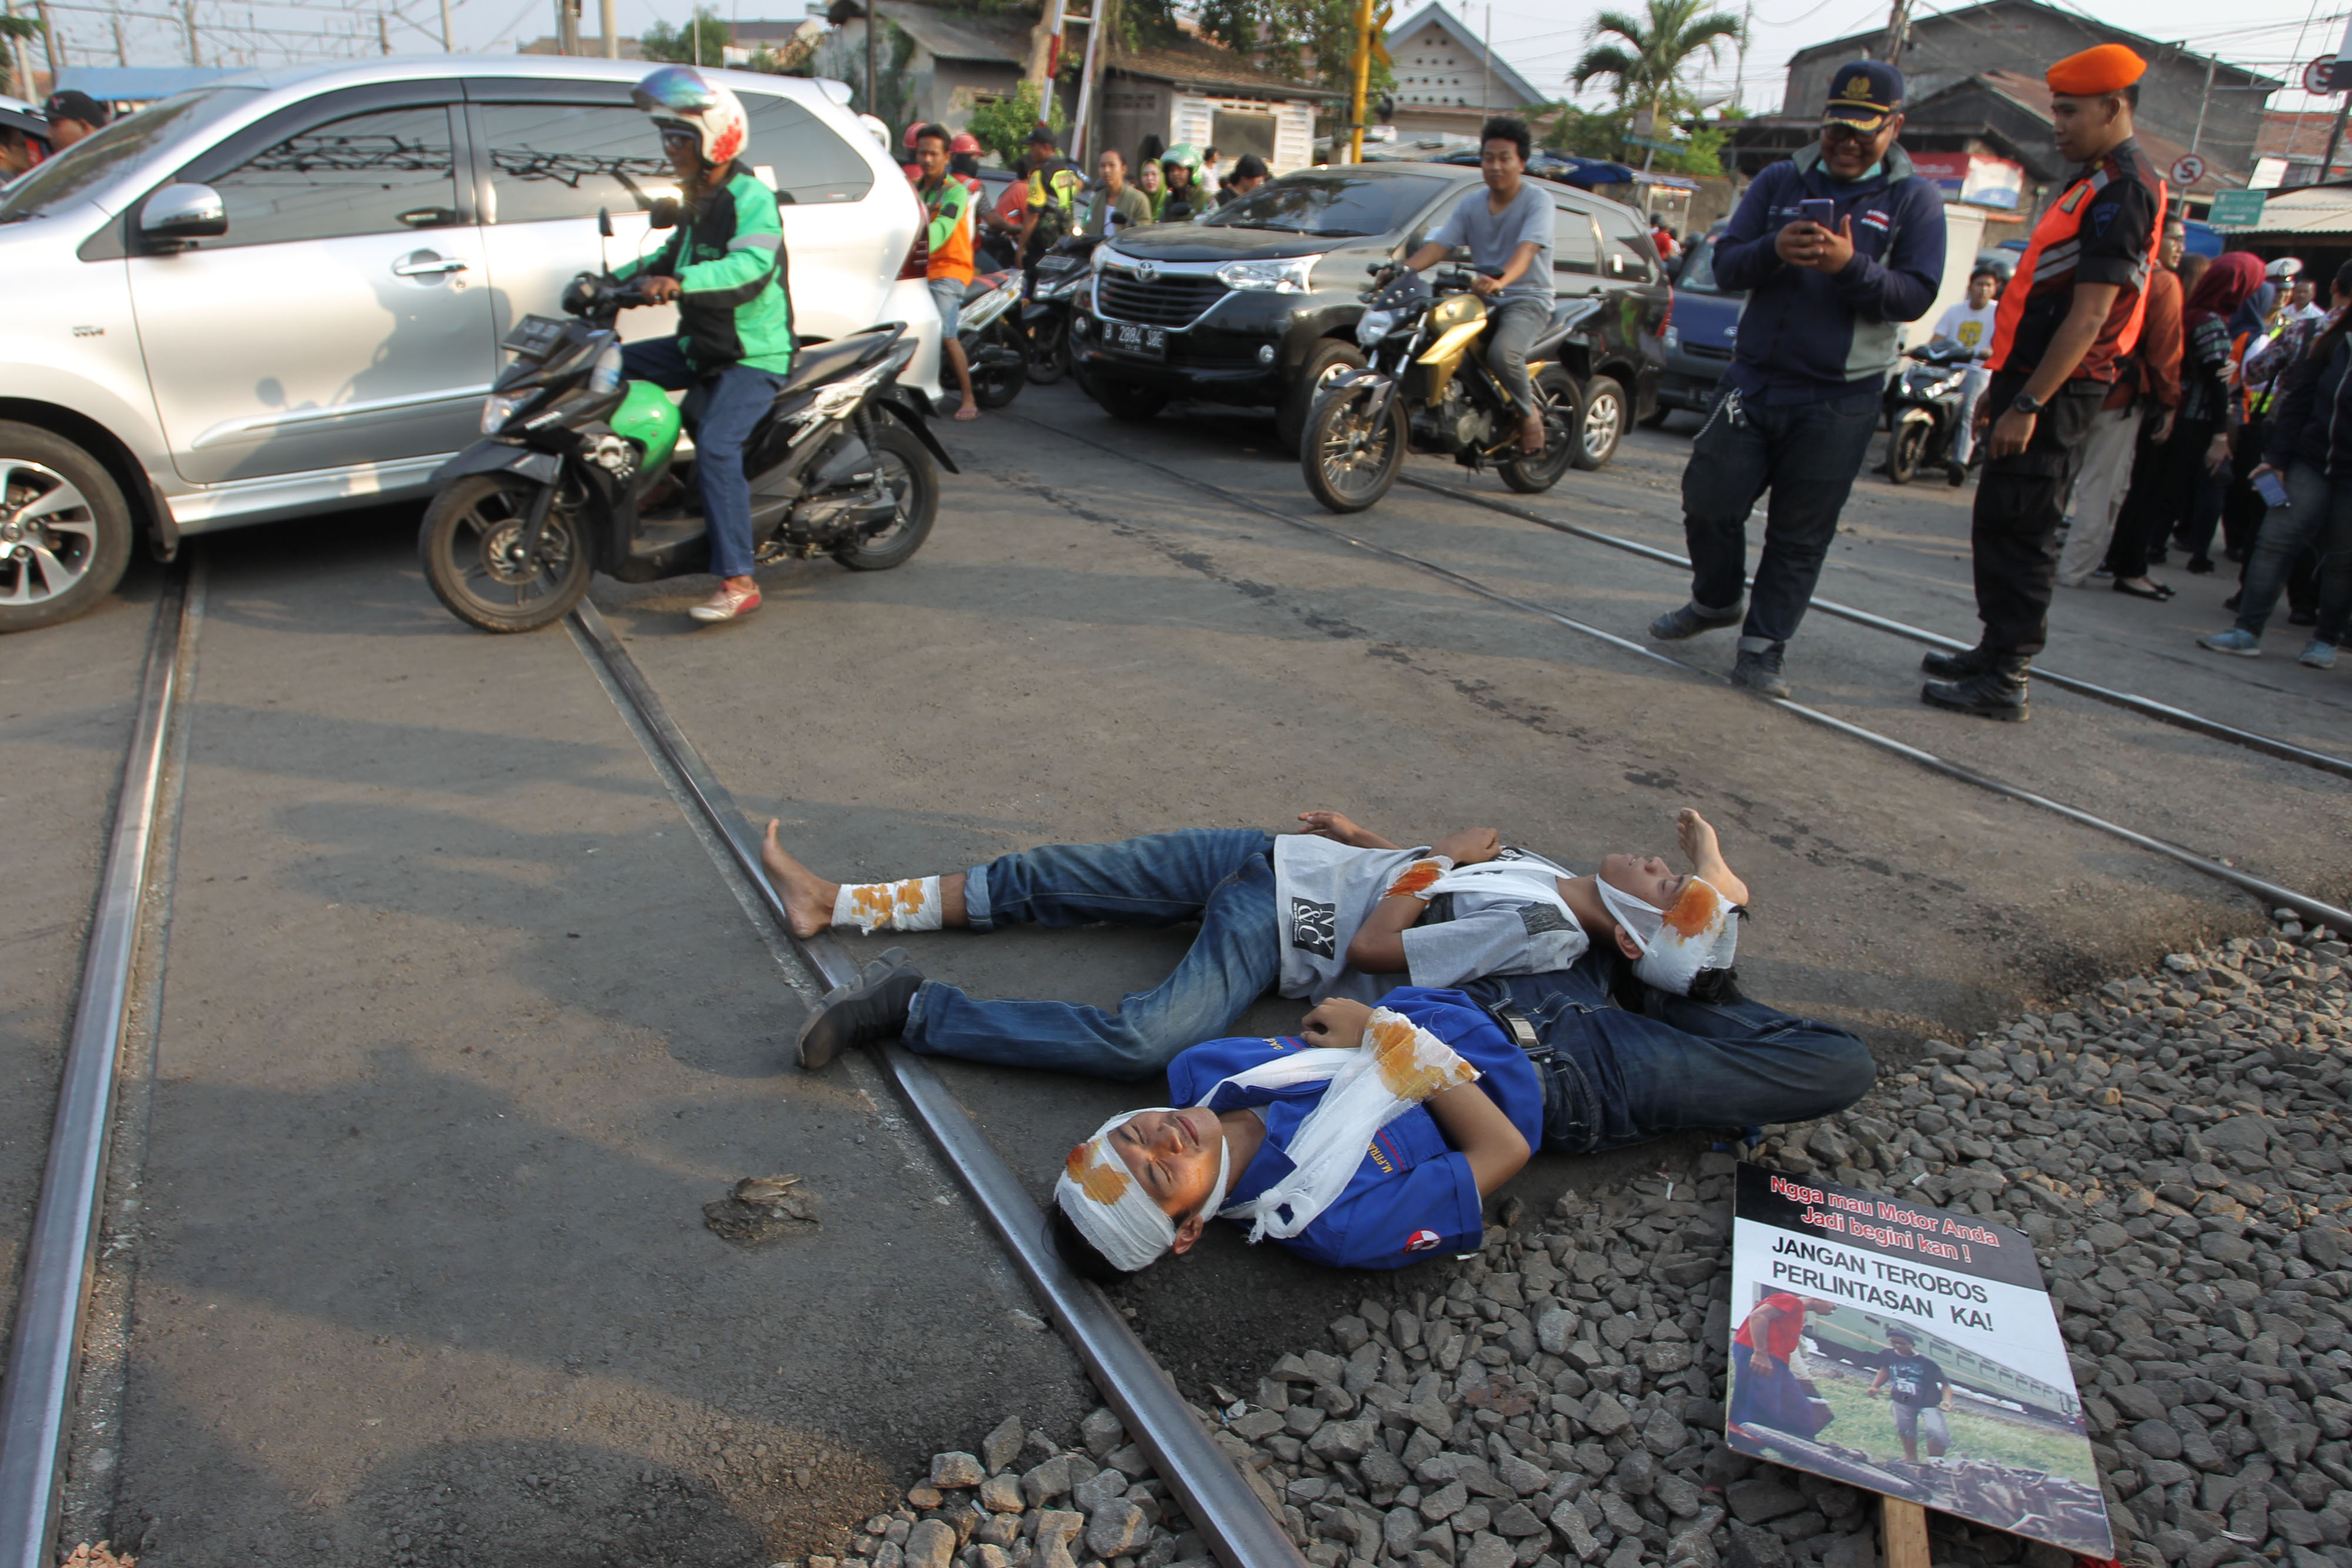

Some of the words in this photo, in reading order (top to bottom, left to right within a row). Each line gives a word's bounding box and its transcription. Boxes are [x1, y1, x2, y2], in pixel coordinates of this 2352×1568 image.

[1770, 1176, 1824, 1204] Ngga
[1828, 1193, 1873, 1216] mau
[1877, 1201, 1939, 1232] Motor
[1942, 1218, 2000, 1247] Anda
[1800, 1206, 1845, 1232] Jadi
[1849, 1217, 1914, 1249] begini
[1917, 1233, 1959, 1260] kan
[1772, 1236, 1866, 1275] JANGAN
[1871, 1260, 1988, 1303] TEROBOS
[1773, 1261, 1934, 1319] PERLINTASAN
[1950, 1305, 1994, 1332] KA!
